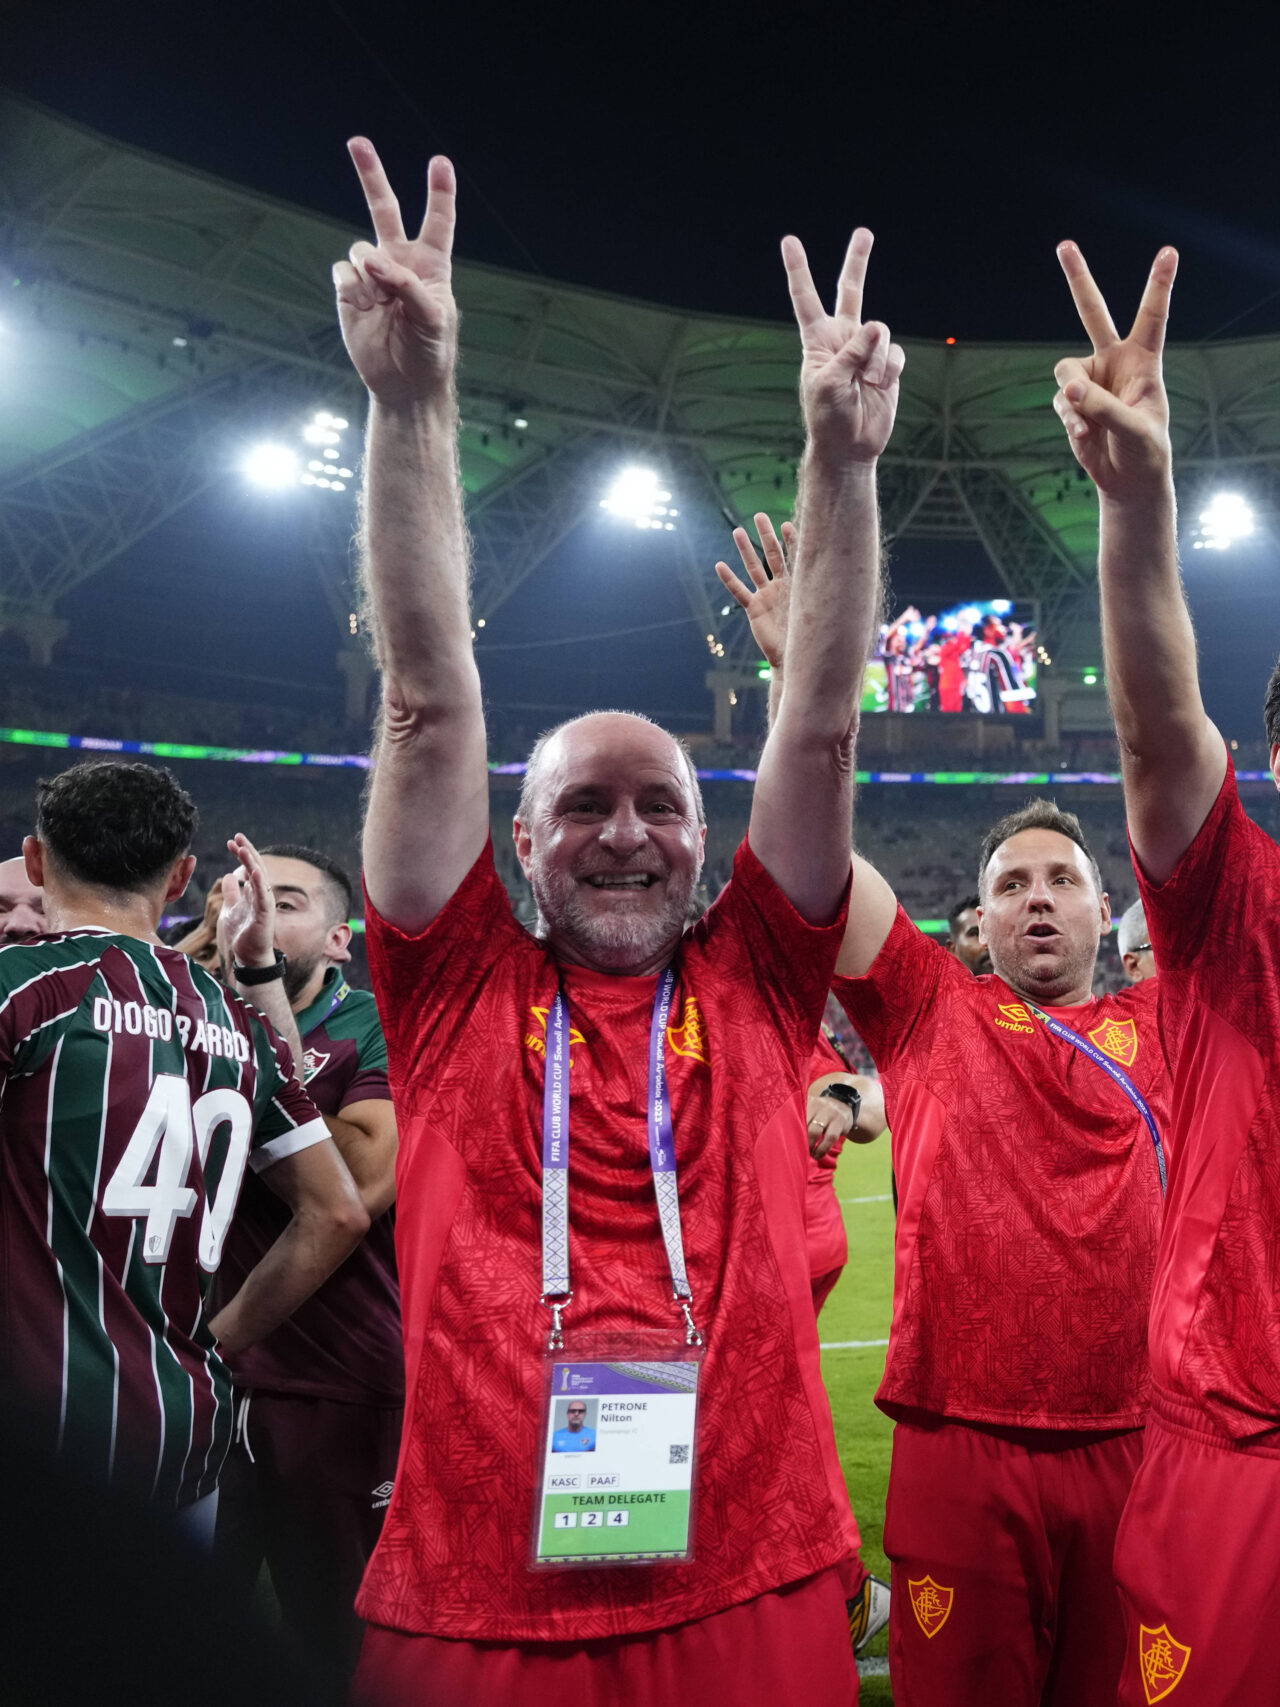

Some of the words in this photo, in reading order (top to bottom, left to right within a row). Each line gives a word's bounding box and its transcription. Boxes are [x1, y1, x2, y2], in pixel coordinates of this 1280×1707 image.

[660, 984, 673, 1012] WORLD
[93, 997, 173, 1042] DIOGO
[658, 1013, 668, 1030] CUP
[994, 1017, 1035, 1034] umbro
[1050, 1022, 1062, 1033] FIFA
[1061, 1030, 1075, 1041] CLUB
[1075, 1037, 1093, 1054] WORLD
[1092, 1051, 1104, 1062] CUP
[552, 1063, 563, 1080] CUP
[552, 1081, 562, 1115] WORLD
[551, 1114, 562, 1140] CLUB
[551, 1140, 561, 1162] FIFA
[101, 1072, 253, 1274] 40
[601, 1402, 648, 1411] PETRONE
[600, 1413, 632, 1423] Nilton
[551, 1477, 578, 1487] KASC
[590, 1476, 617, 1485] PAAF
[572, 1495, 605, 1506] TEAM
[607, 1493, 667, 1505] DELEGATE
[562, 1514, 569, 1526] 1
[587, 1513, 597, 1525] 2
[612, 1512, 623, 1524] 4
